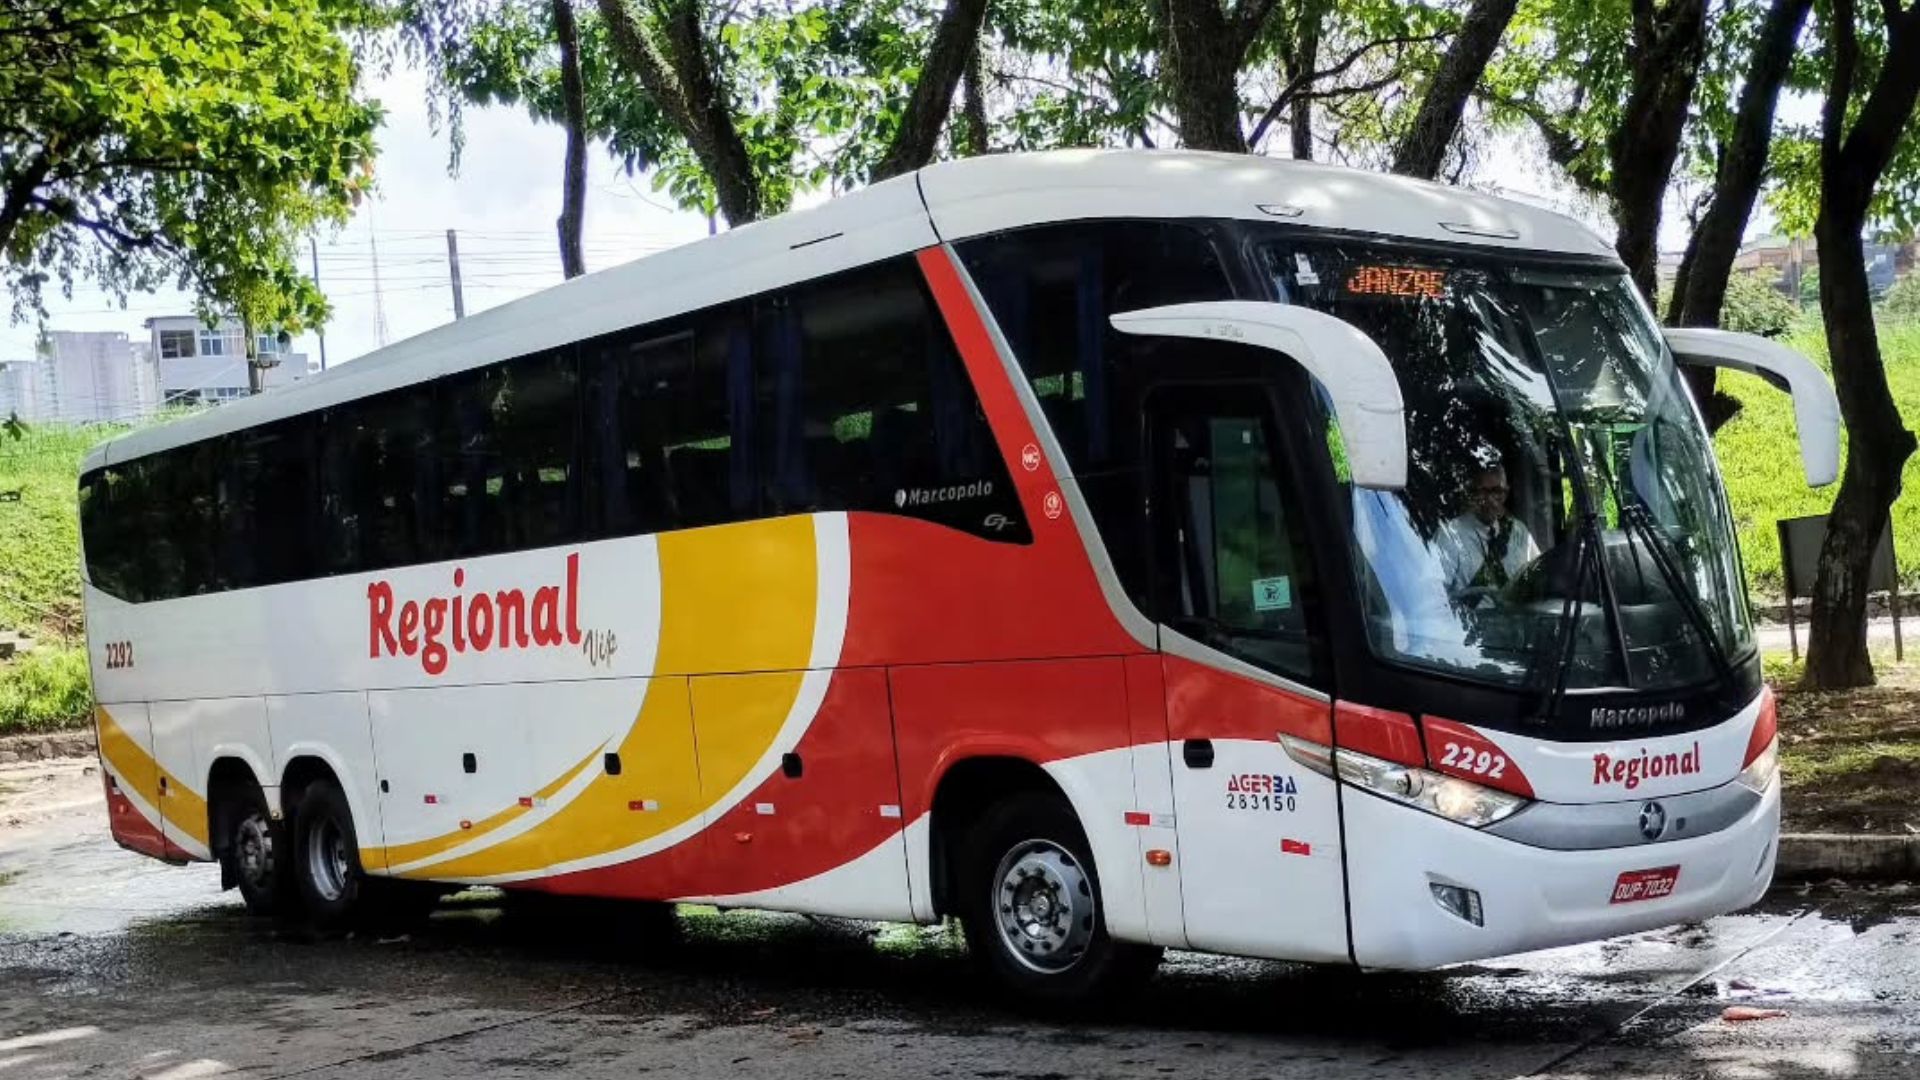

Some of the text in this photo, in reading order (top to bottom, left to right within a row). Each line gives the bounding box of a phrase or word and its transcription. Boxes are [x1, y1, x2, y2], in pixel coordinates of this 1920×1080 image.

[909, 480, 993, 504] Marcopolo
[368, 552, 581, 675] Regional
[105, 641, 134, 669] 2292
[1591, 701, 1685, 727] Marcopolo
[1440, 742, 1506, 779] 2292
[1593, 741, 1700, 789] Regional
[1227, 774, 1298, 794] AGERBA
[1226, 793, 1296, 811] 283150
